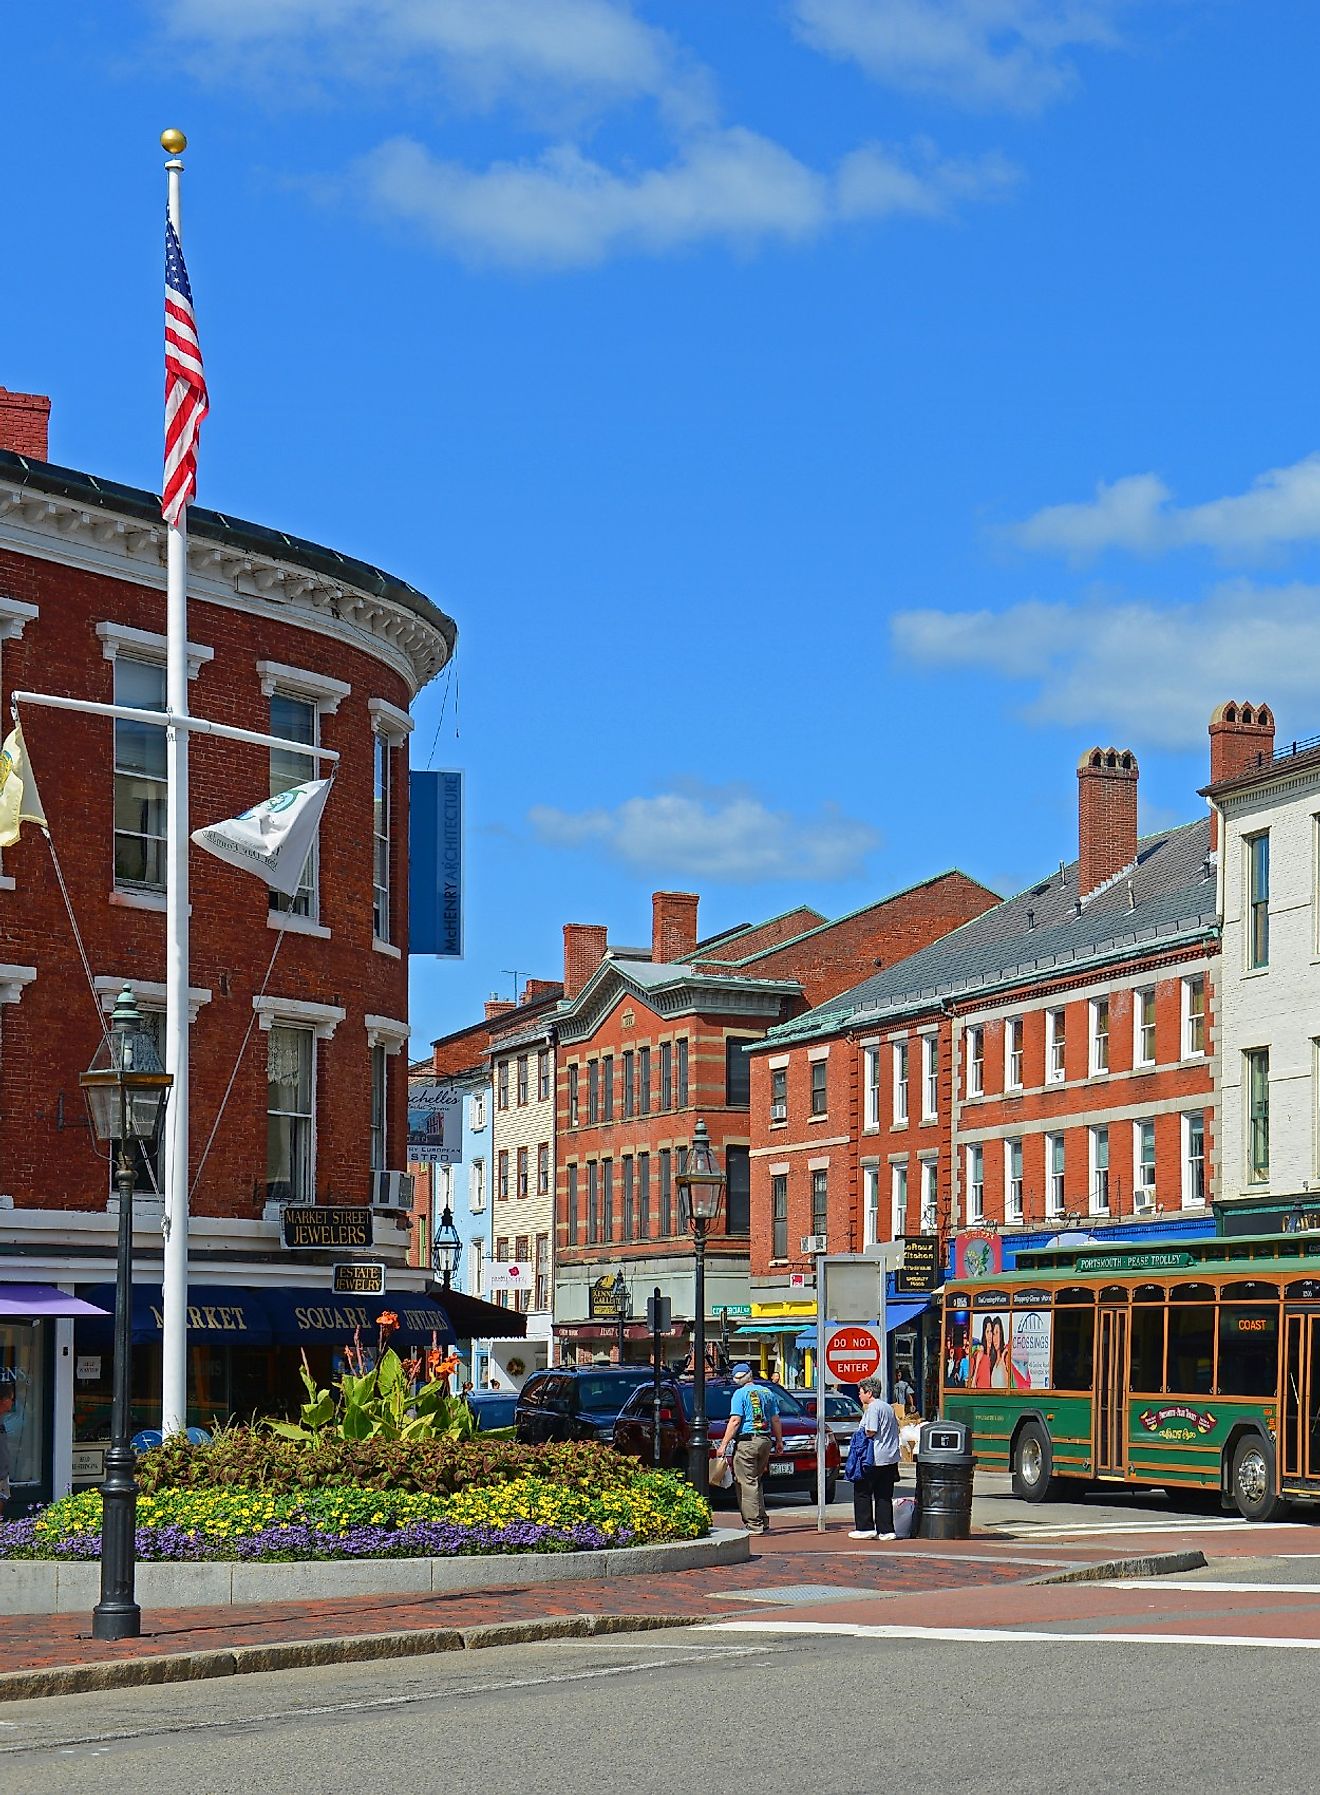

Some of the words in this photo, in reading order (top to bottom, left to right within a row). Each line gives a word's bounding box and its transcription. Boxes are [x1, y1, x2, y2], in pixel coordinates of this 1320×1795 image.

[443, 775, 458, 882] ARCHITECTURE
[443, 883, 457, 951] McHENRY
[408, 1089, 460, 1105] ichelle's
[285, 1210, 329, 1225] MARKET
[332, 1210, 371, 1225] STREET
[293, 1225, 367, 1245] JEWELERS
[1081, 1257, 1122, 1269] PORTSMOUTH
[1127, 1256, 1149, 1267] PEASE
[1151, 1254, 1181, 1266] TROLLEY
[339, 1267, 379, 1279] ESTATE
[336, 1278, 382, 1291] JEWELRY
[150, 1304, 248, 1330] MRKET
[294, 1307, 372, 1330] SQUARE
[1239, 1319, 1267, 1331] COAST
[833, 1338, 847, 1348] DO
[852, 1337, 873, 1348] NOT
[837, 1363, 869, 1373] ENTER
